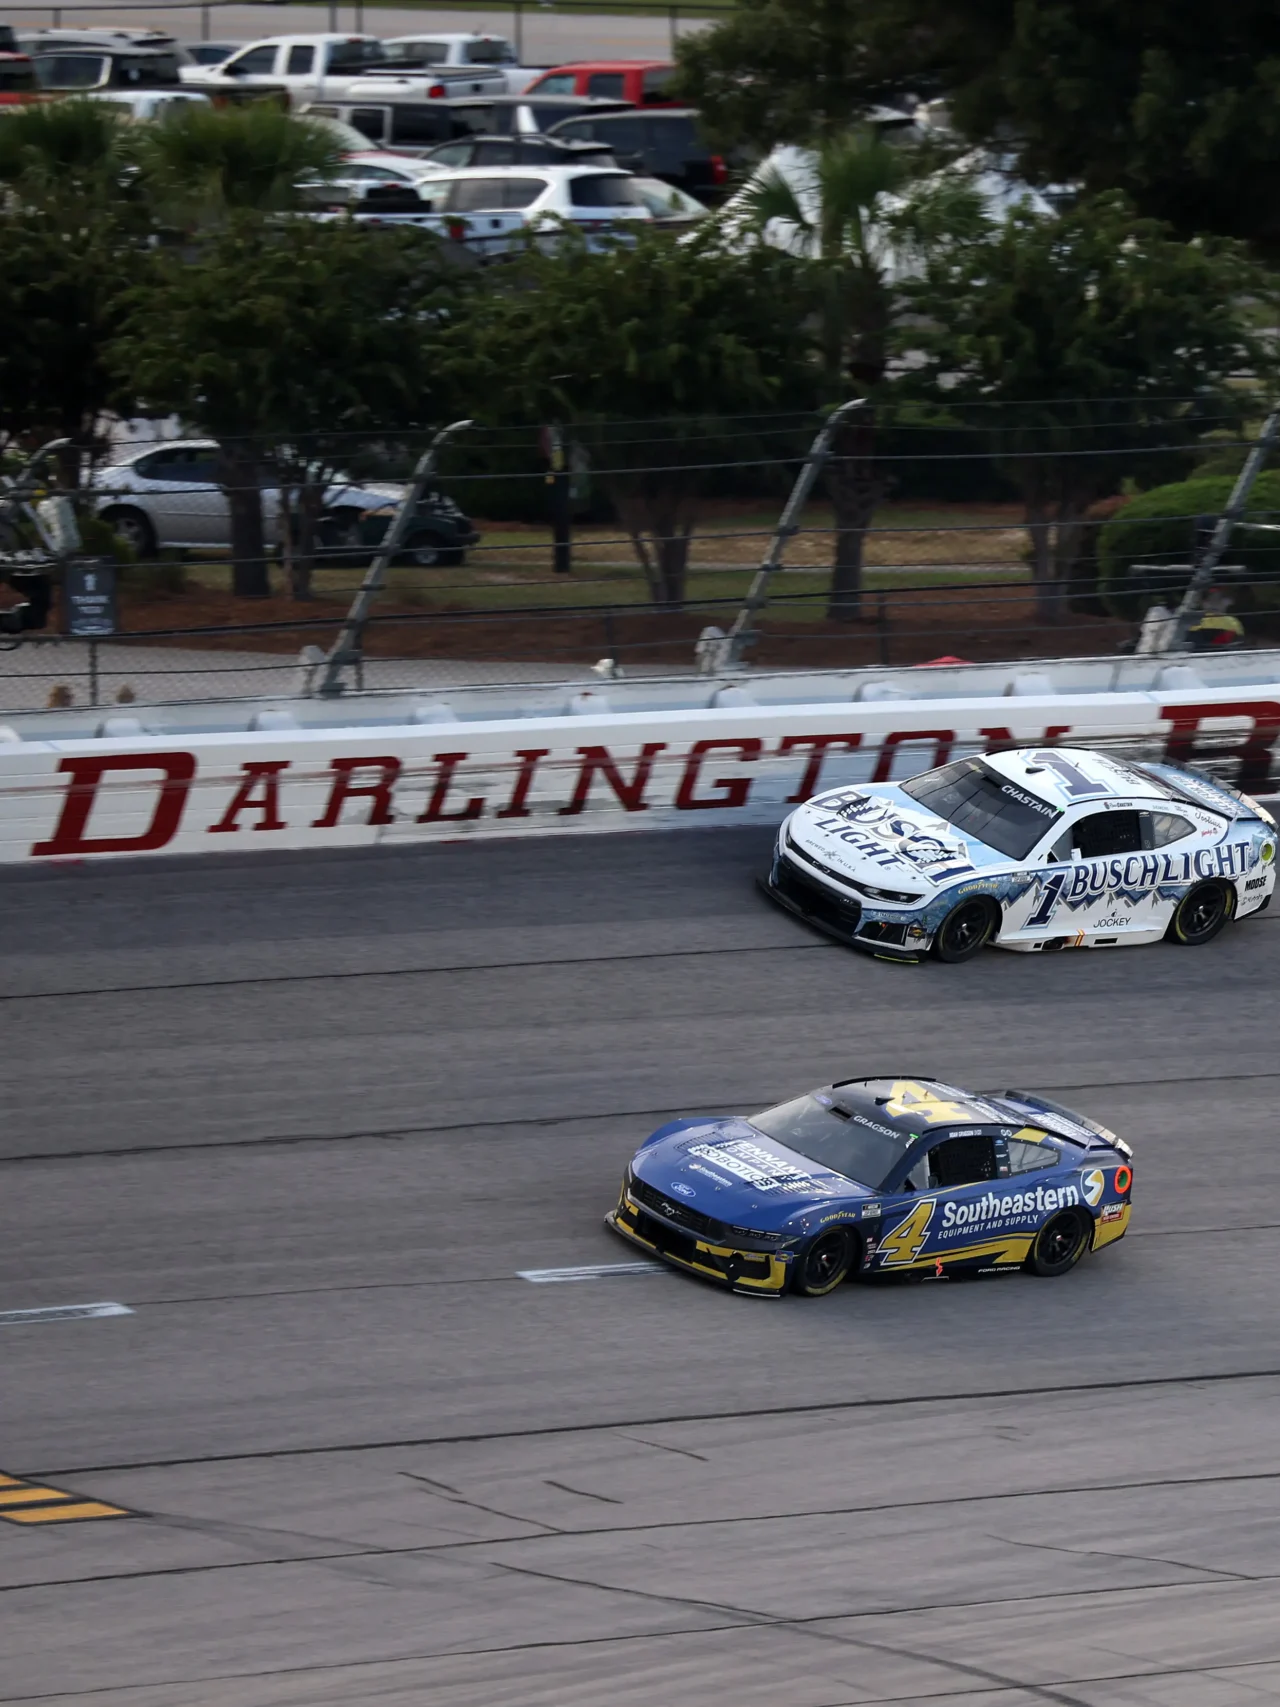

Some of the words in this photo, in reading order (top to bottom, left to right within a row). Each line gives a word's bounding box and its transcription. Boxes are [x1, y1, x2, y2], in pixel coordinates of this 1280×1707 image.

[1029, 751, 1112, 797] 1
[1001, 784, 1058, 820] CHASTAIN
[813, 818, 906, 868] LIGHT
[1070, 854, 1159, 899] BUSCH
[1160, 841, 1252, 883] LIGHT
[1245, 875, 1268, 892] MOOSE
[1024, 873, 1066, 928] 1
[1093, 917, 1132, 929] JOCKEY
[885, 1081, 972, 1123] 4
[853, 1114, 901, 1140] GRAGSON
[819, 1210, 856, 1224] GOODYEAR
[937, 1224, 985, 1240] EQUIPMENT
[986, 1219, 1003, 1230] AND
[1004, 1214, 1040, 1227] SUPPLY
[941, 1184, 1079, 1228] Southeastern
[876, 1199, 937, 1266] 4
